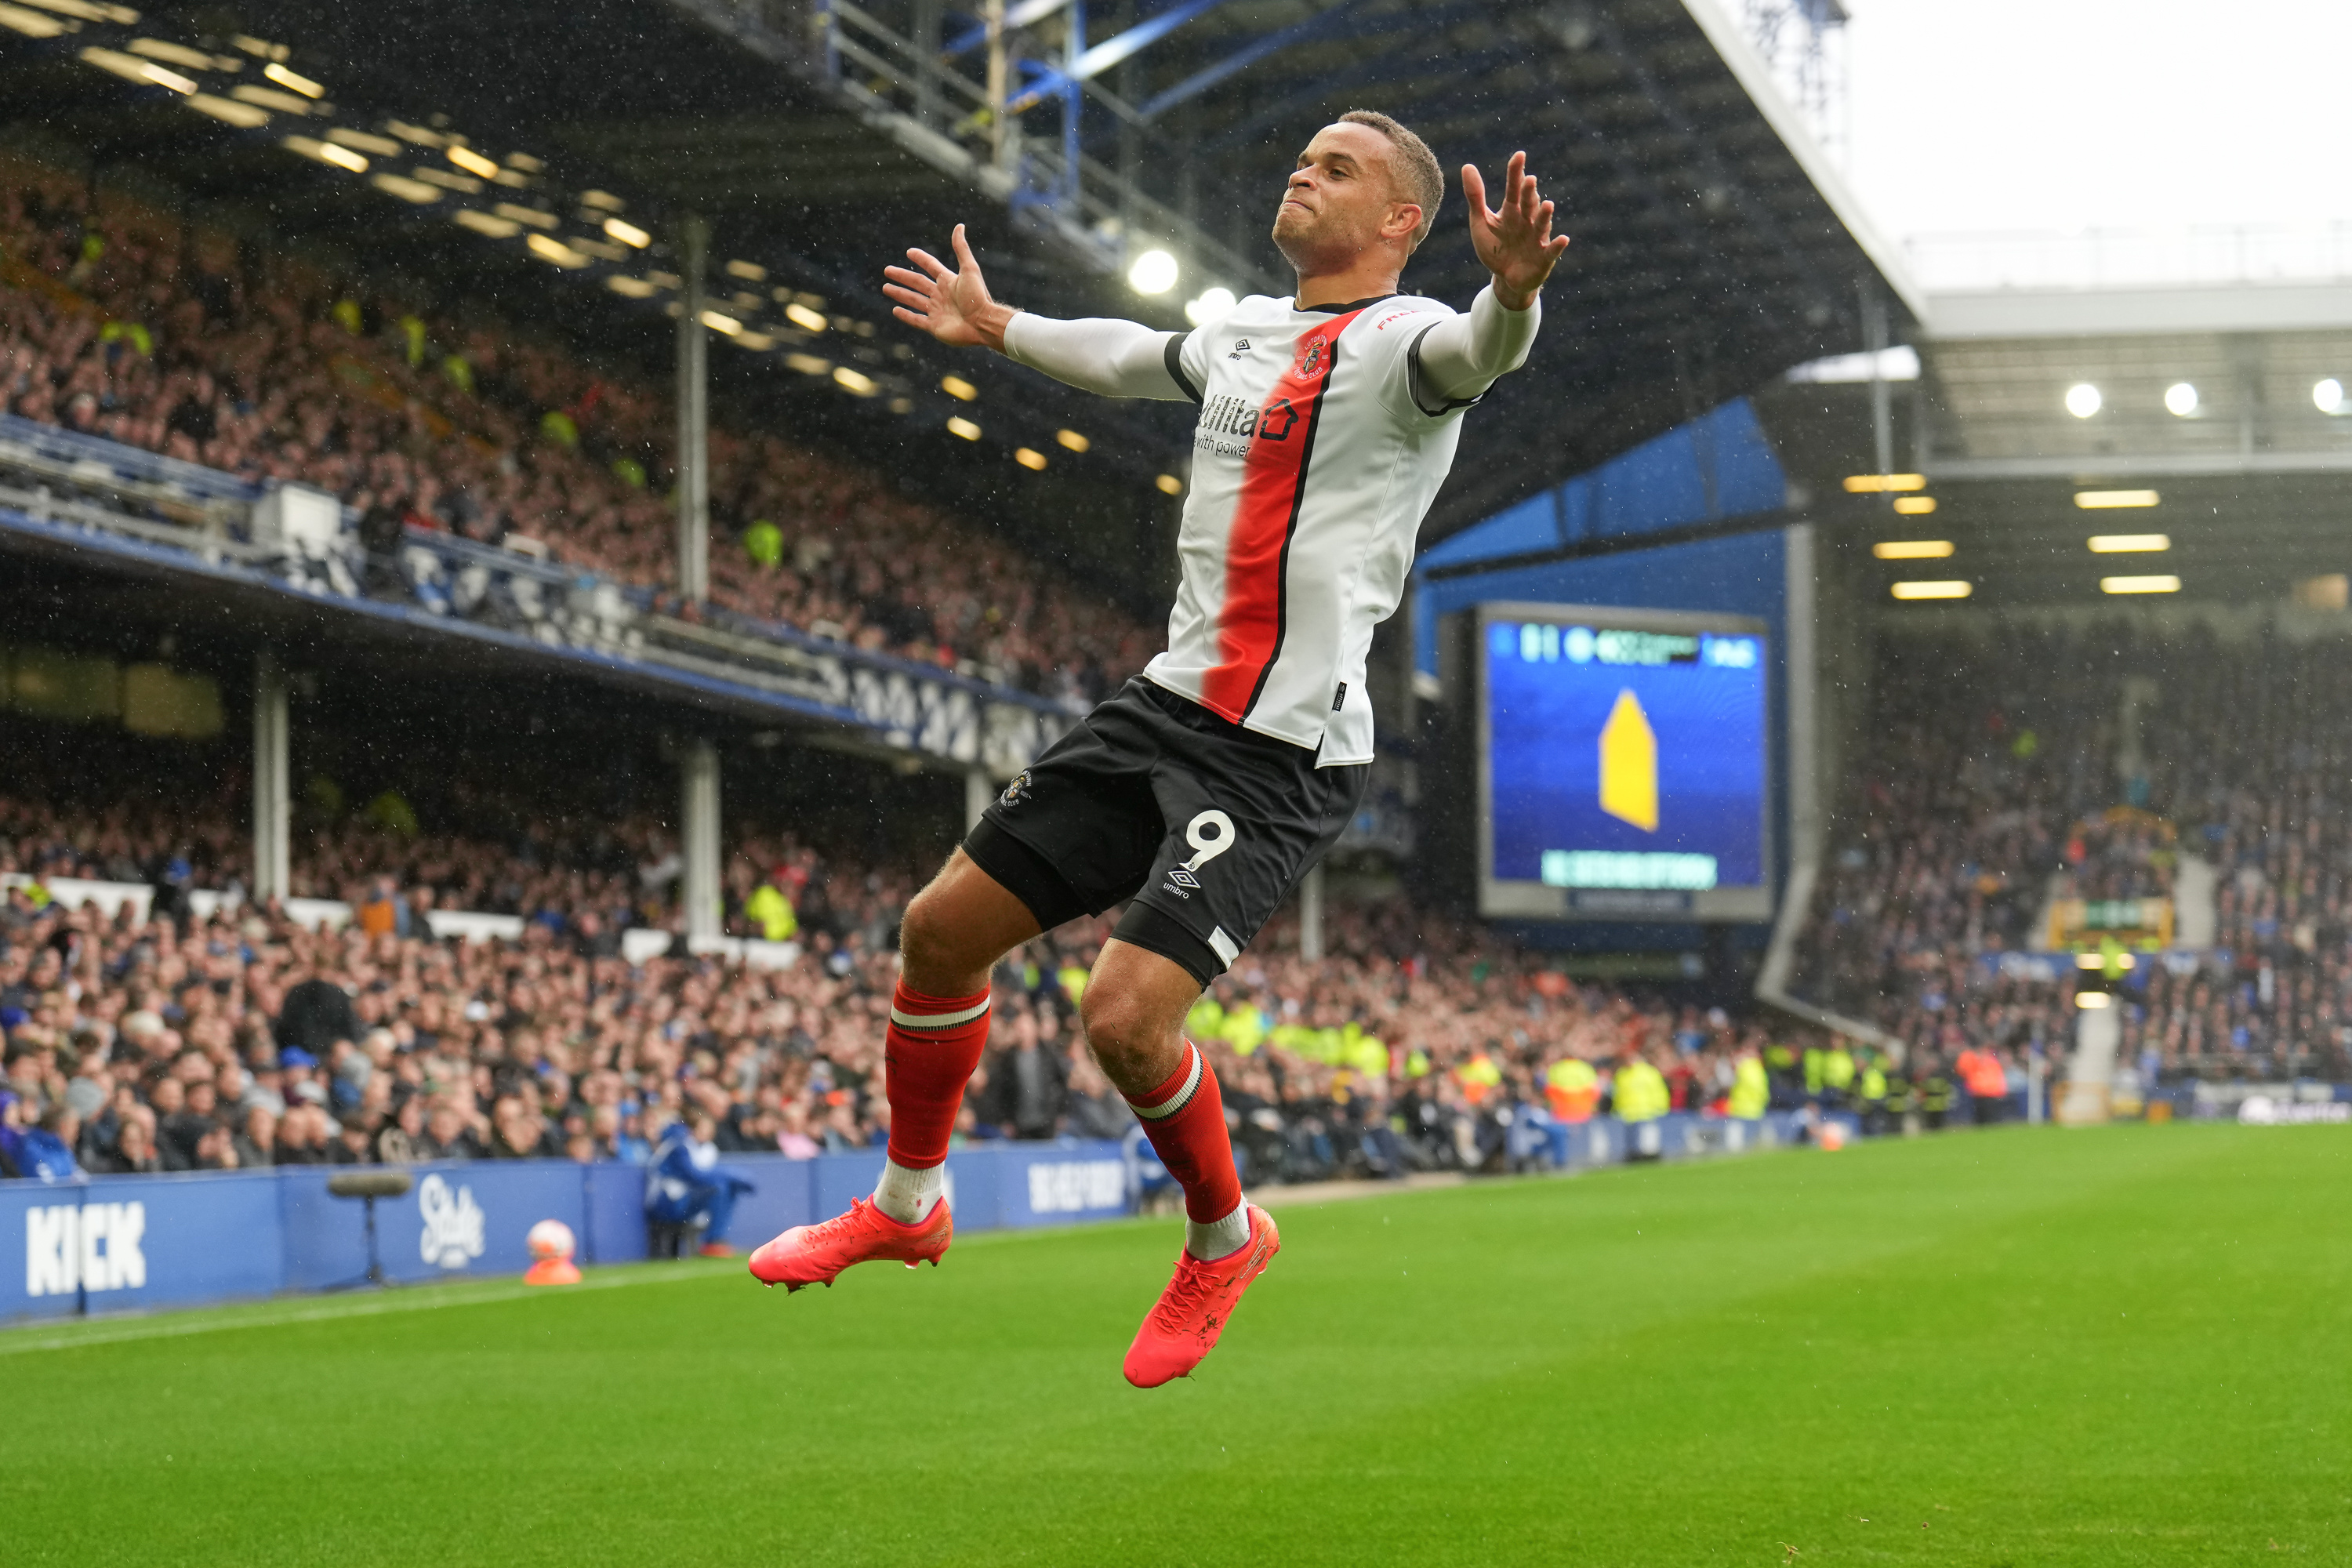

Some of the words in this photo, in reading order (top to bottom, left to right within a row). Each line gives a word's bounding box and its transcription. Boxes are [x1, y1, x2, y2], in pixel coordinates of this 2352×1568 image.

[1196, 434, 1214, 451] with
[1216, 441, 1251, 457] power
[1178, 809, 1236, 873] 9
[1163, 882, 1189, 899] umbro
[26, 1201, 146, 1296] KICK
